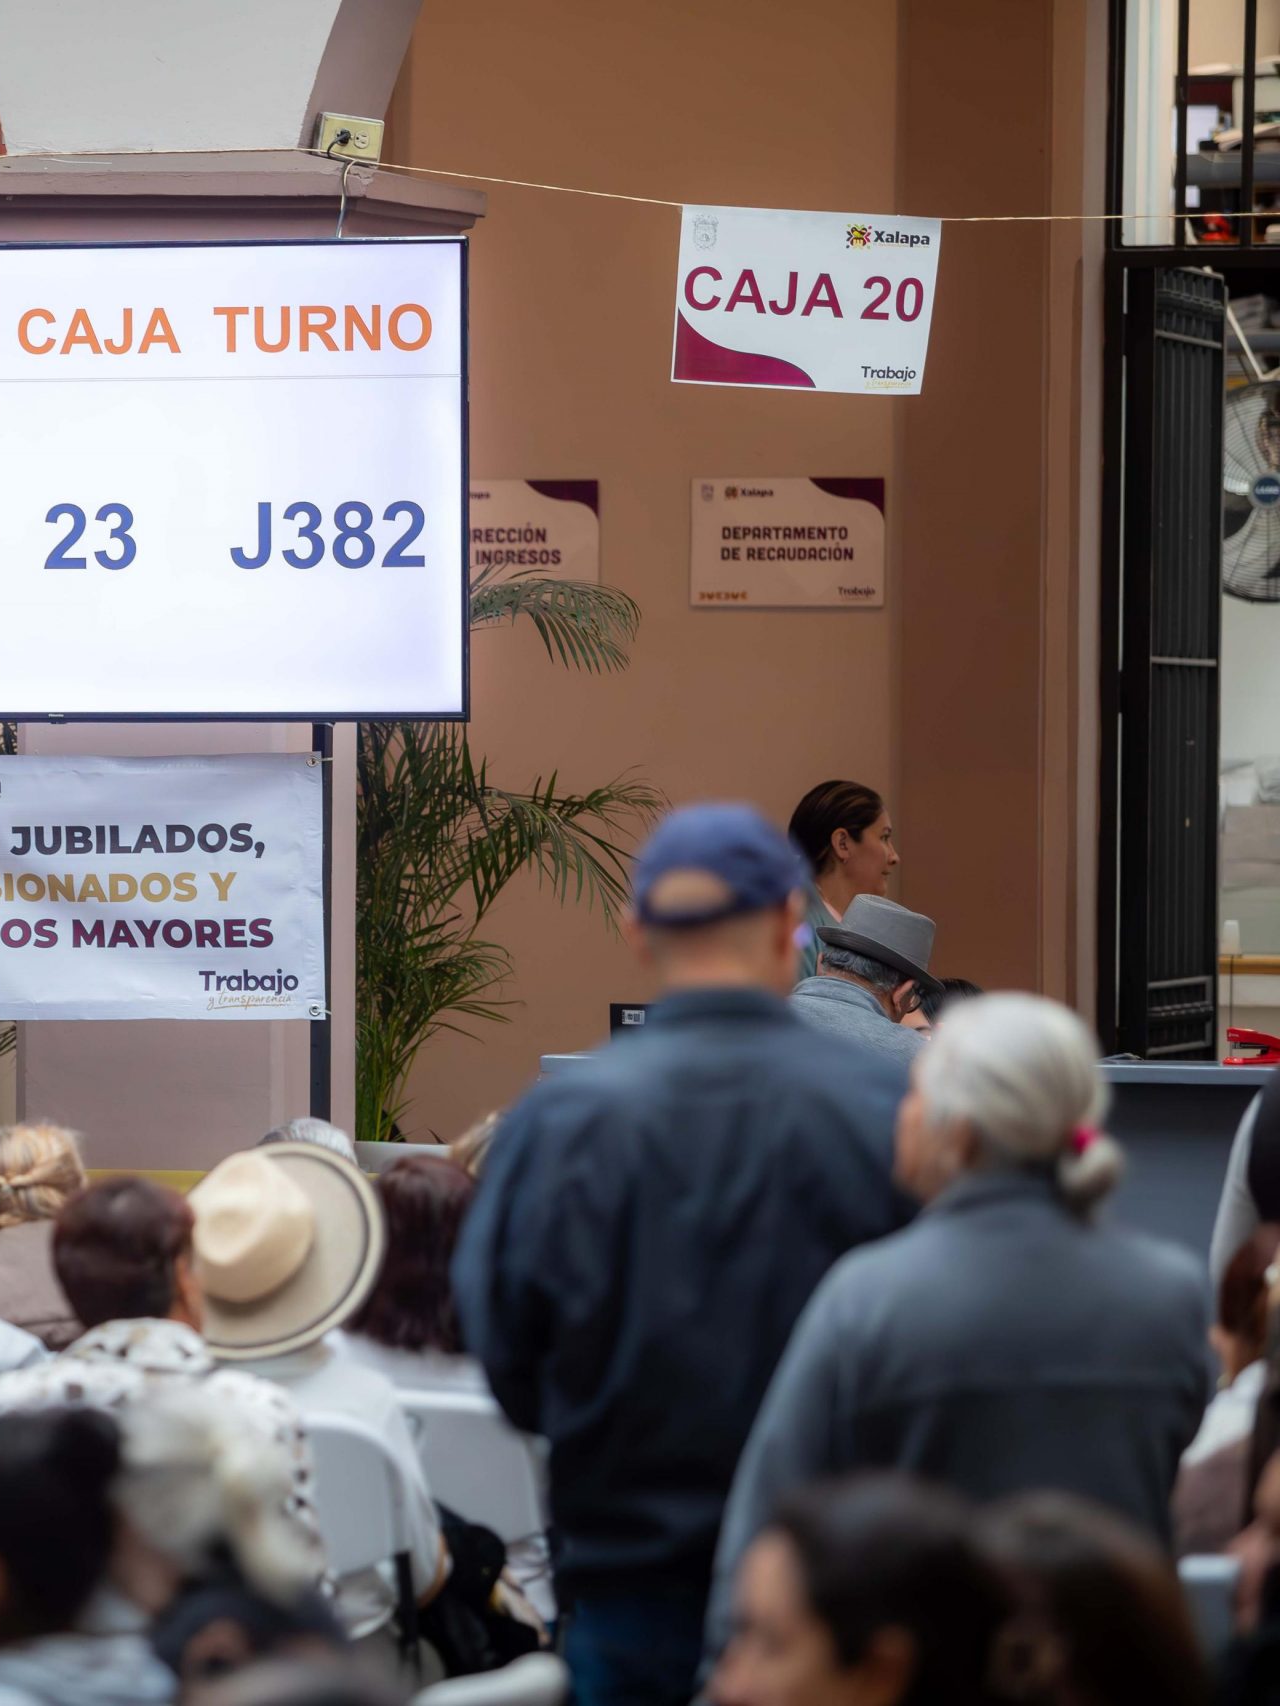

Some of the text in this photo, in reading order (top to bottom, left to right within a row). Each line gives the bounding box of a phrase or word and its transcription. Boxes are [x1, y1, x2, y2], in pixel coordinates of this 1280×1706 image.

[873, 230, 931, 248] Xalapa
[684, 265, 925, 323] CAJA 20
[17, 303, 433, 355] CAJA TURNO
[860, 365, 917, 382] Trabajo
[44, 500, 427, 571] 23 J382
[469, 522, 547, 543] RECCIÓN
[722, 526, 849, 540] DEPARTAMENTO
[475, 549, 561, 565] INGRESOS
[721, 542, 854, 561] DE RECAUDACIÓN
[9, 822, 266, 859] JUBILADOS,
[208, 871, 238, 902] Y
[72, 917, 274, 949] MAYORES
[199, 968, 299, 996] Trabajo
[218, 989, 292, 1010] transparencia
